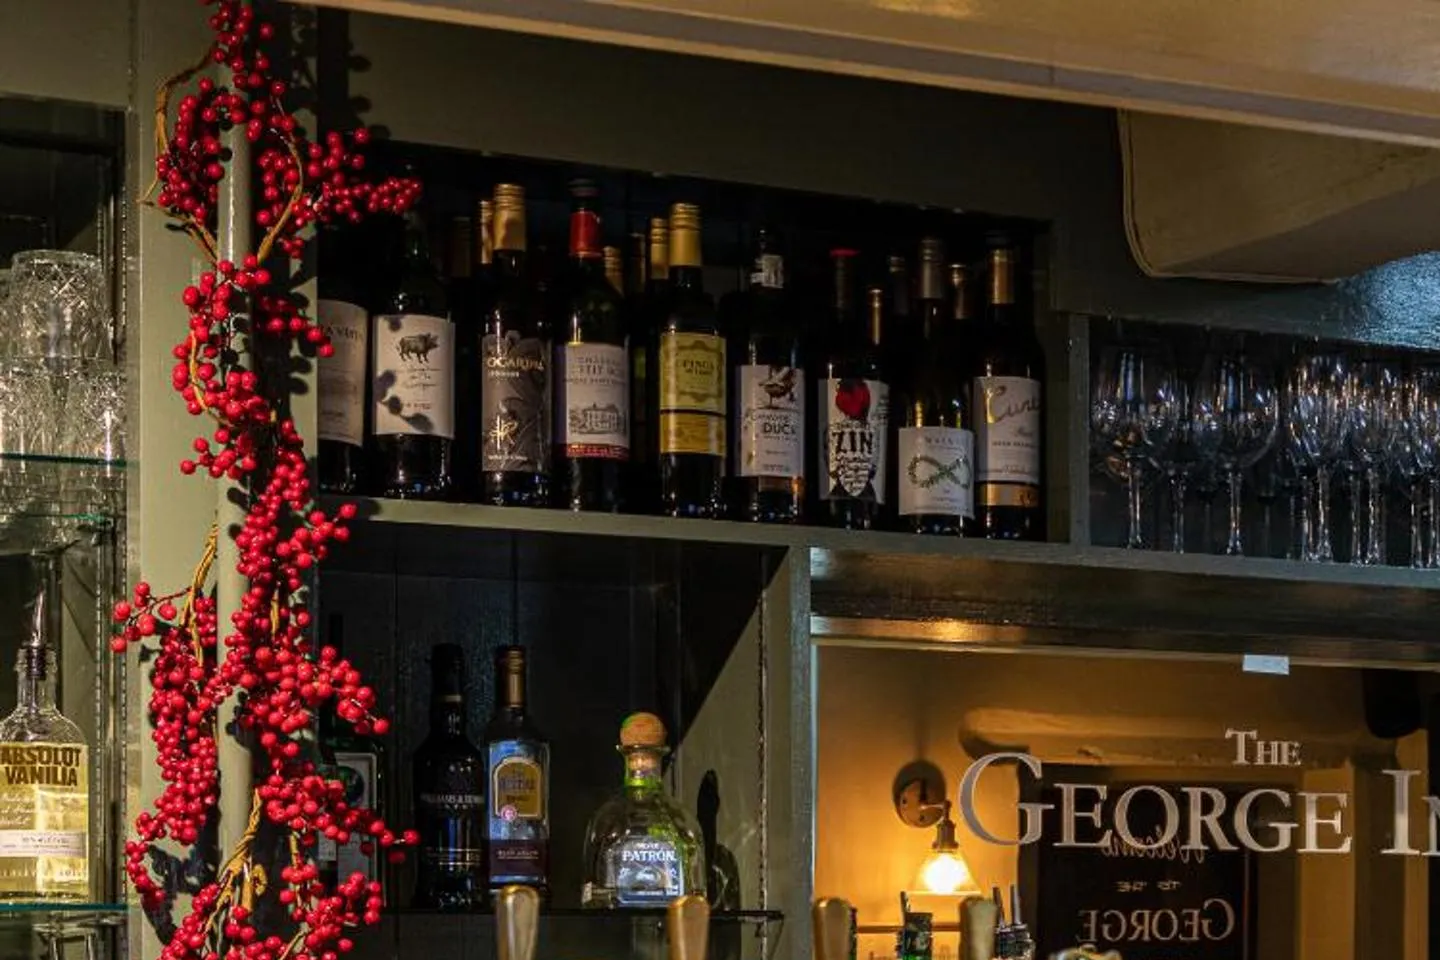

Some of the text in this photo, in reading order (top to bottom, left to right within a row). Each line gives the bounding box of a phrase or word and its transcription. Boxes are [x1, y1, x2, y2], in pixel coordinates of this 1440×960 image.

[832, 431, 873, 455] ZIN
[0, 745, 81, 767] ABSOLUT
[1225, 728, 1302, 766] THE
[4, 766, 78, 787] VANILIA
[959, 752, 1353, 854] GEORGE
